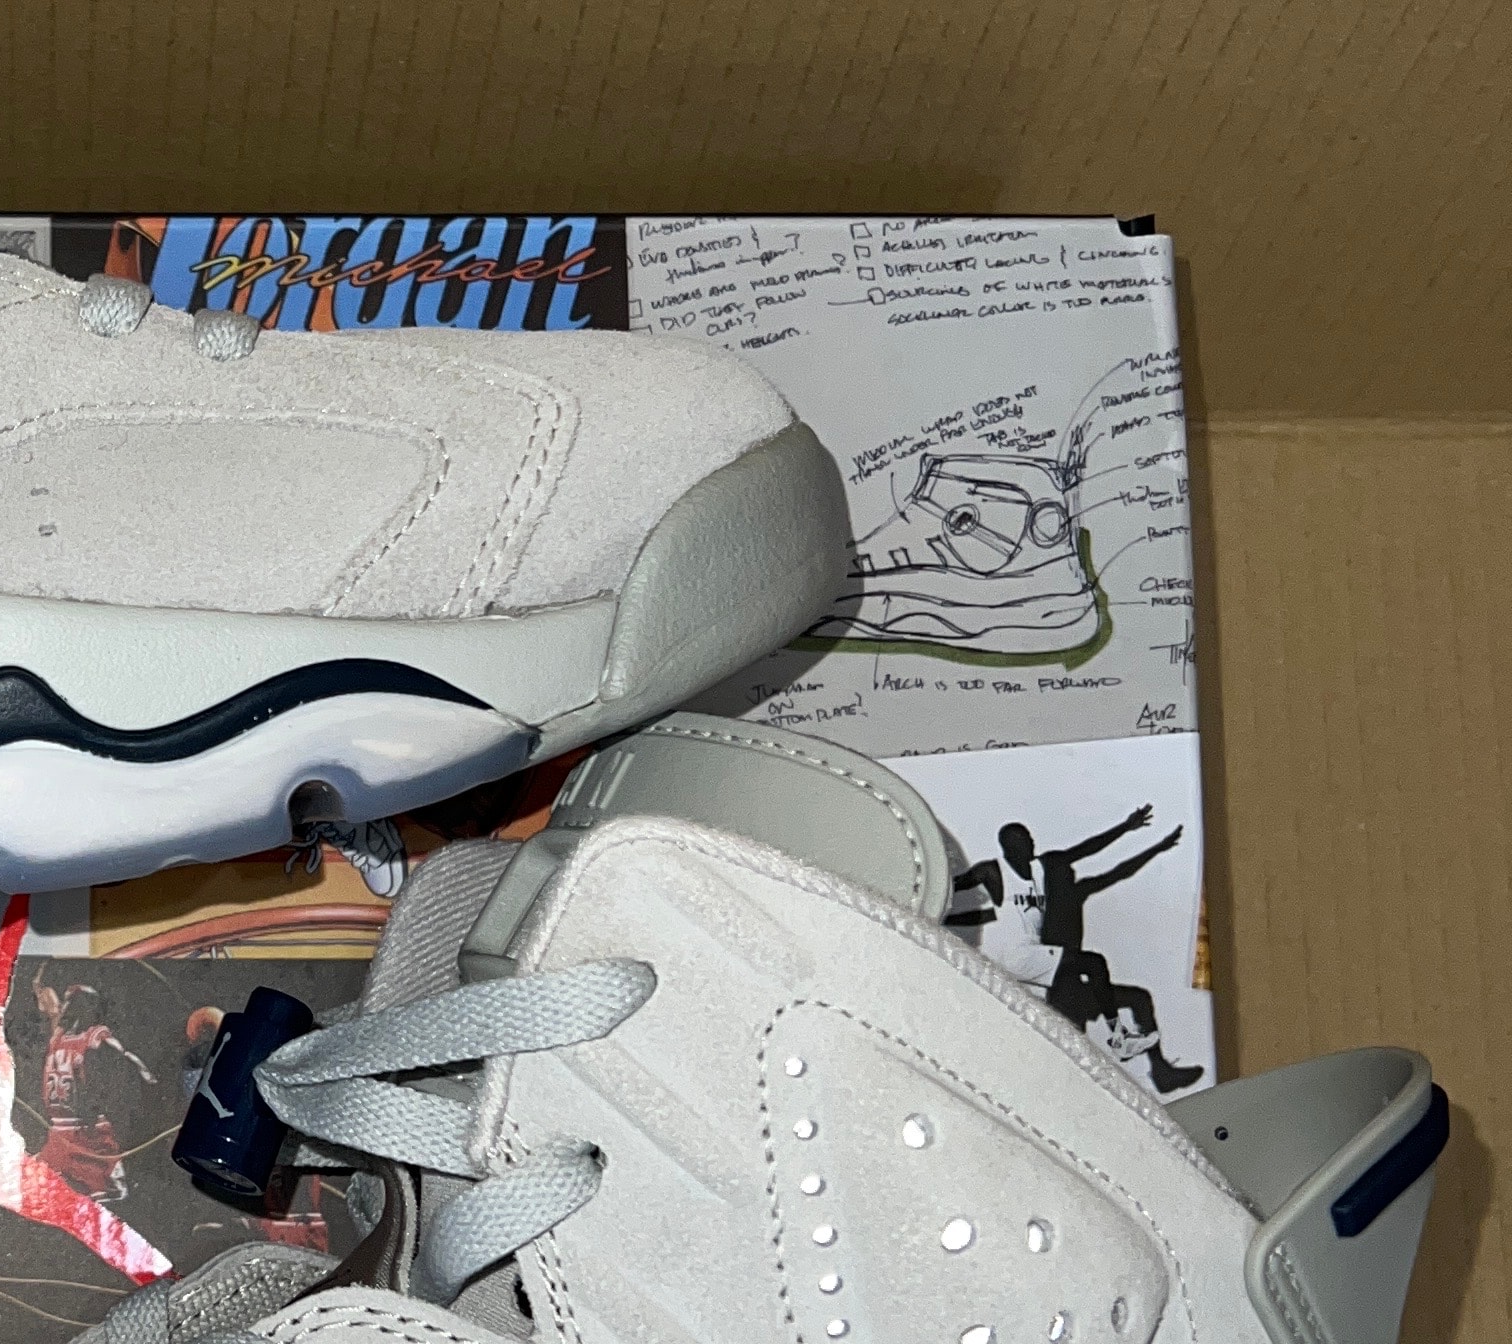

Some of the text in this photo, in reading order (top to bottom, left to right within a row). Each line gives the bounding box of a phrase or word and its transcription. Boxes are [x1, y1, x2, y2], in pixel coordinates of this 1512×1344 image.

[659, 311, 697, 331] DID
[882, 674, 925, 690] ARCH
[935, 680, 948, 692] IS
[992, 681, 1027, 694] FAR
